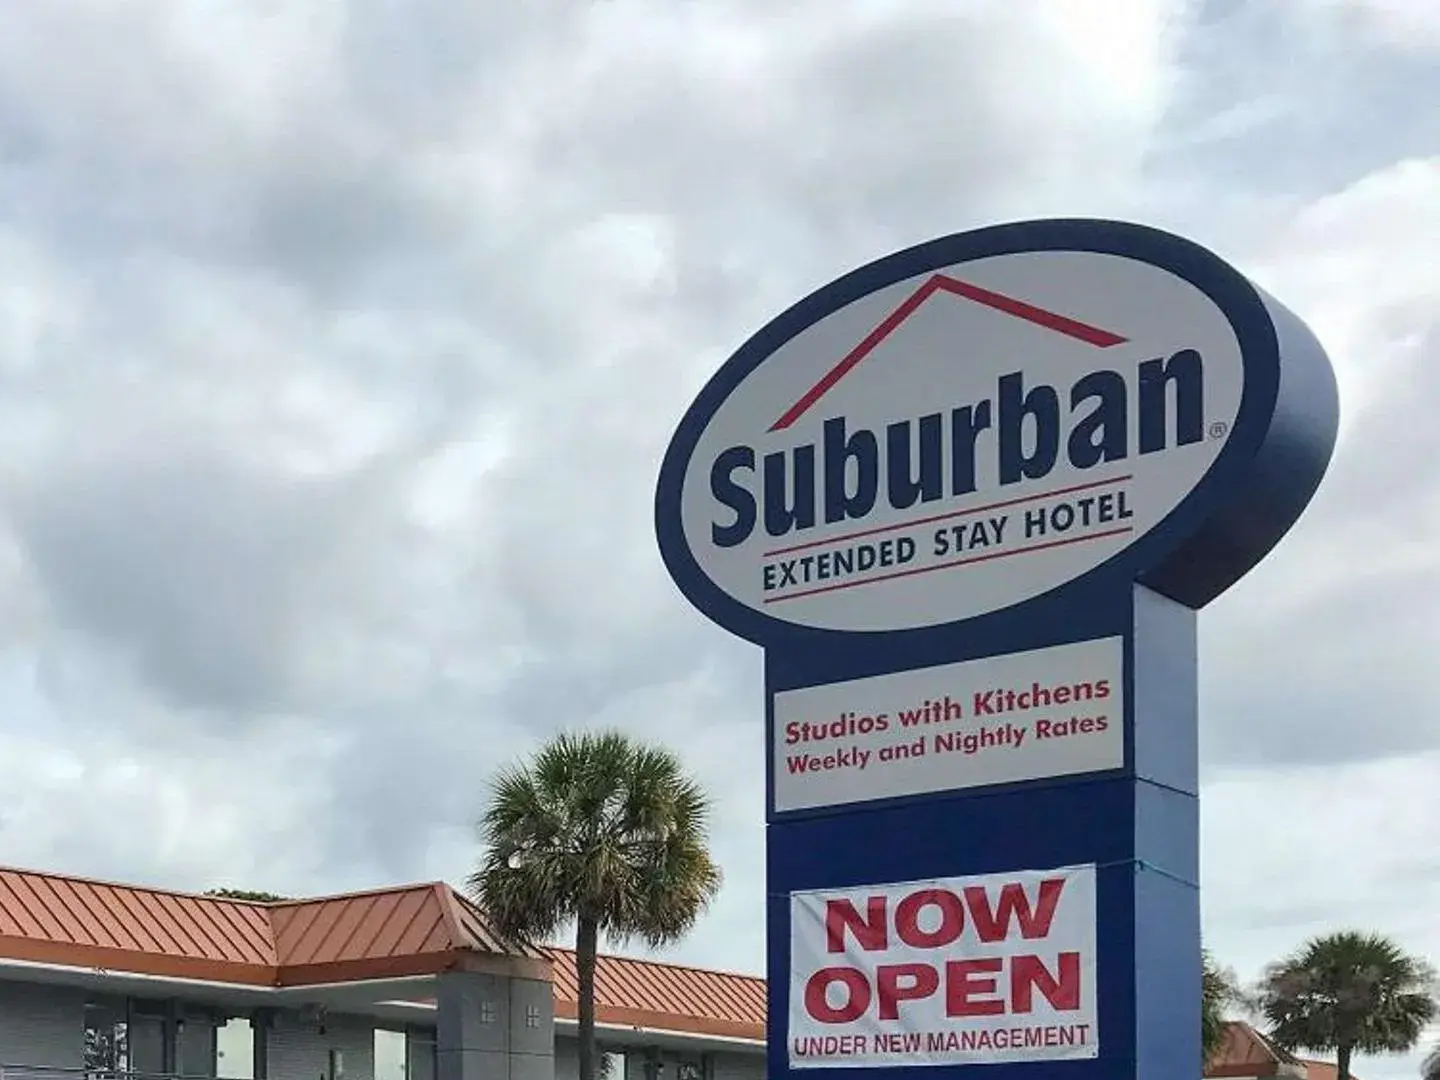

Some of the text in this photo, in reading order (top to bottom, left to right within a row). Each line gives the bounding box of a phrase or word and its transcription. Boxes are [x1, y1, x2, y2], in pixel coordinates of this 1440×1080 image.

[710, 349, 1205, 548] Suburban
[763, 491, 1134, 591] EXTENDED STAY HOTEL
[784, 678, 1111, 745] Studios with Kitchens
[787, 713, 1109, 775] Weekly and Nightly Rates
[825, 877, 1066, 954] NOW
[803, 951, 1081, 1024] OPEN
[794, 1023, 1091, 1057] UNDER NEW MANAGEMENT
